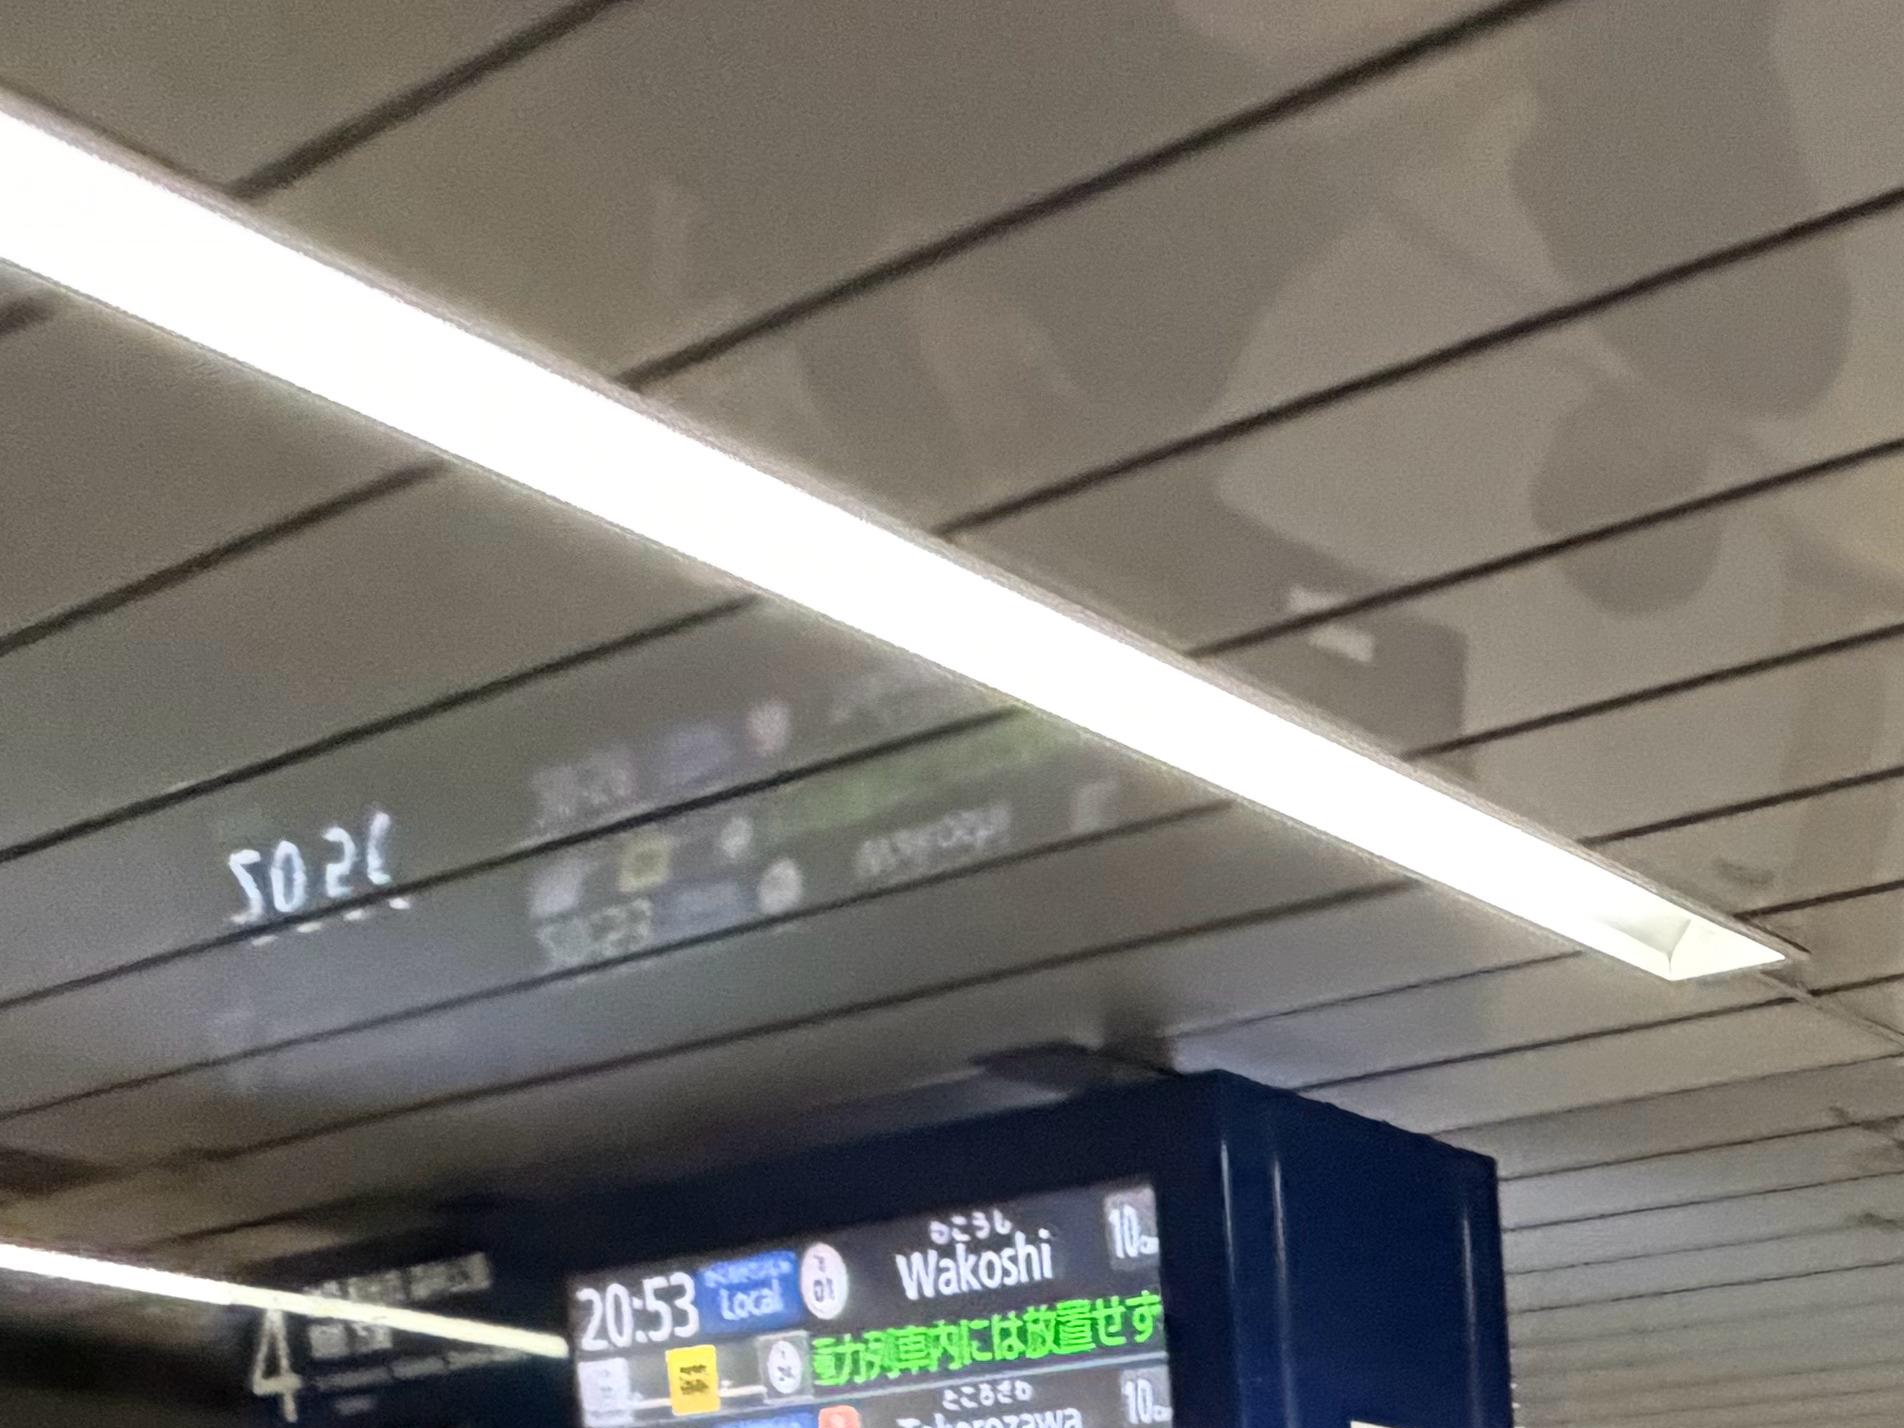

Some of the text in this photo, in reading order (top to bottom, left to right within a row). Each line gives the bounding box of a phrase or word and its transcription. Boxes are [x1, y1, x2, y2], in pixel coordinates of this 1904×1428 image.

[577, 1272, 699, 1351] 20:53
[720, 1279, 783, 1320] Local
[896, 1228, 1053, 1300] Wakoshi
